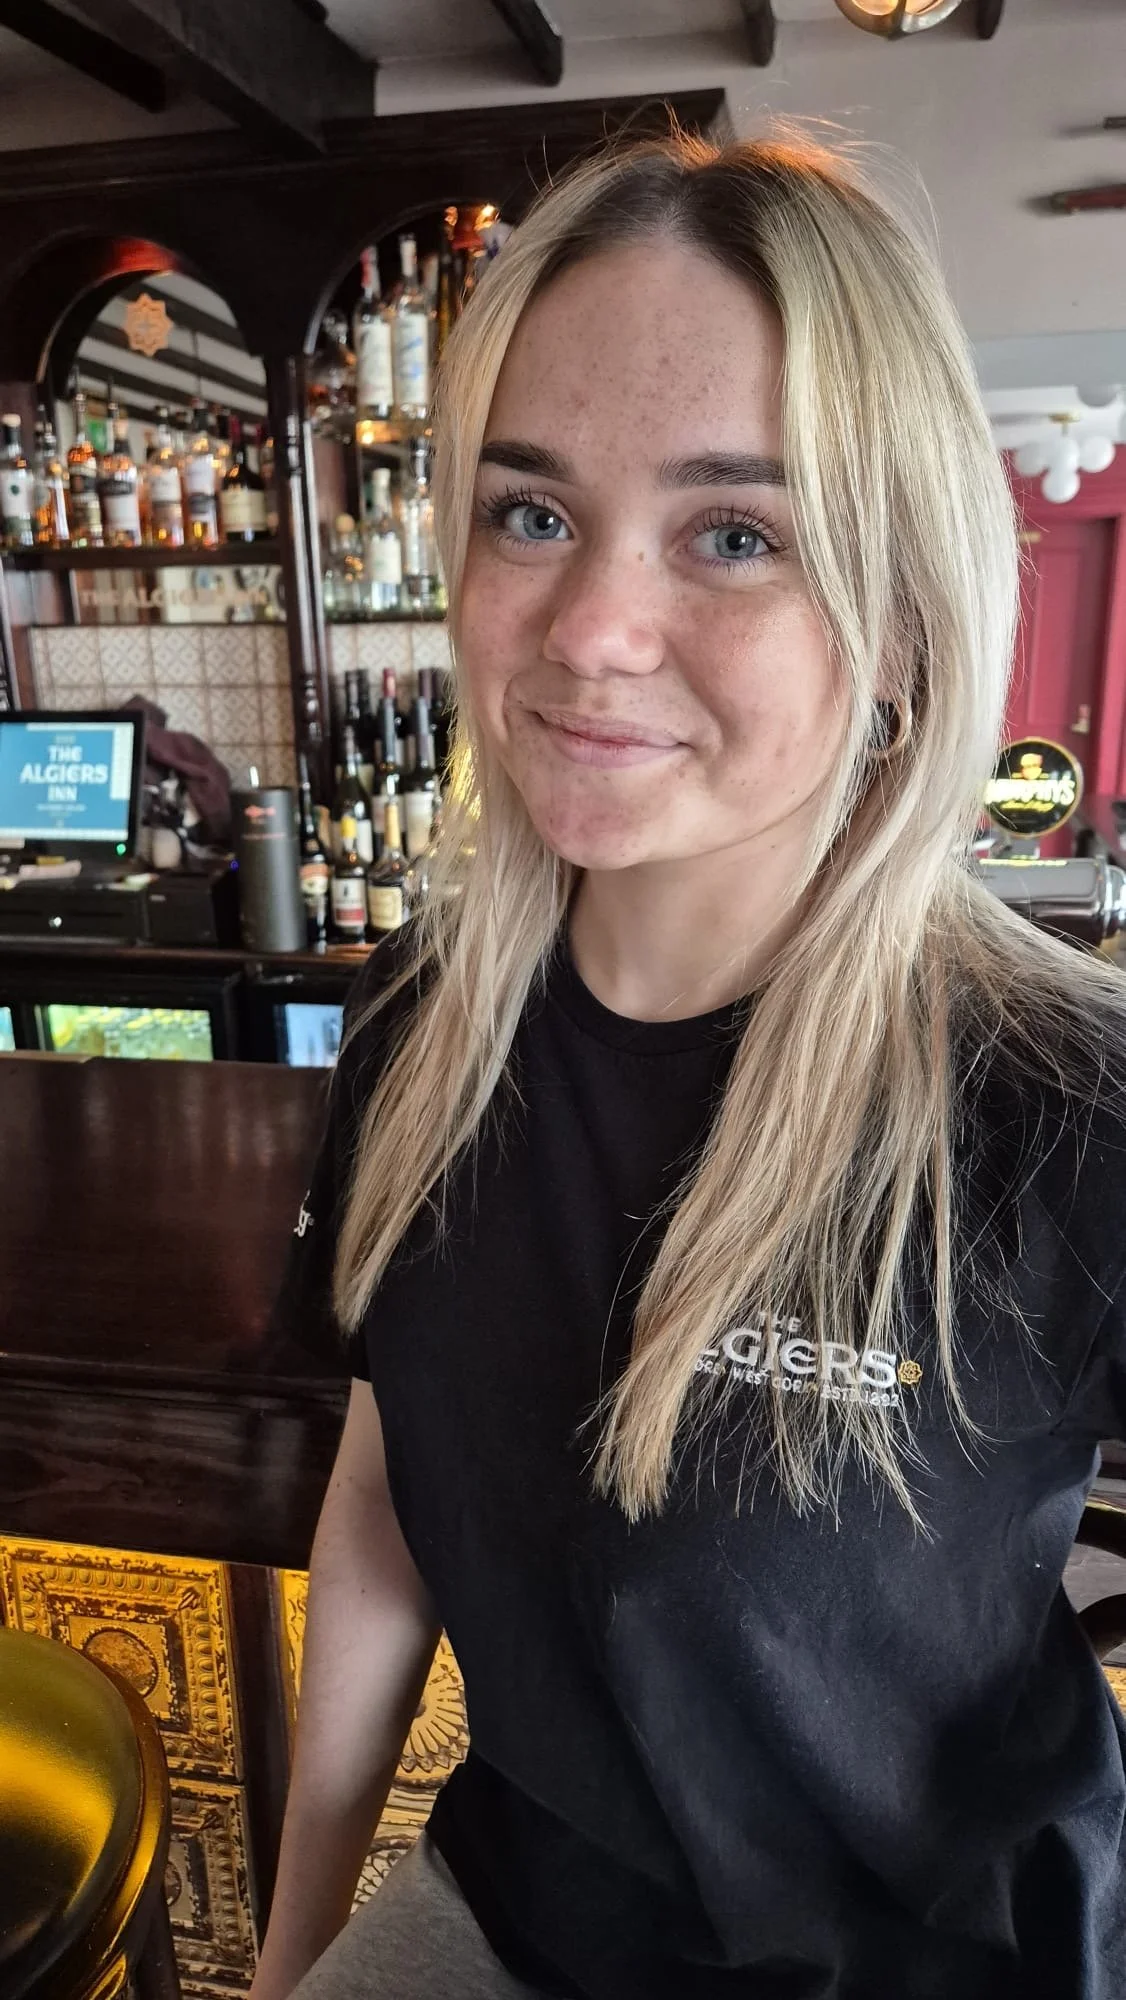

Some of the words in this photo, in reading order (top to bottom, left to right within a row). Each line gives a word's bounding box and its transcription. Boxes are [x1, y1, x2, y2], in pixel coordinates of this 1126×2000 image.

[48, 745, 83, 762] THE
[20, 763, 109, 784] ALGIERS
[47, 785, 78, 801] INN
